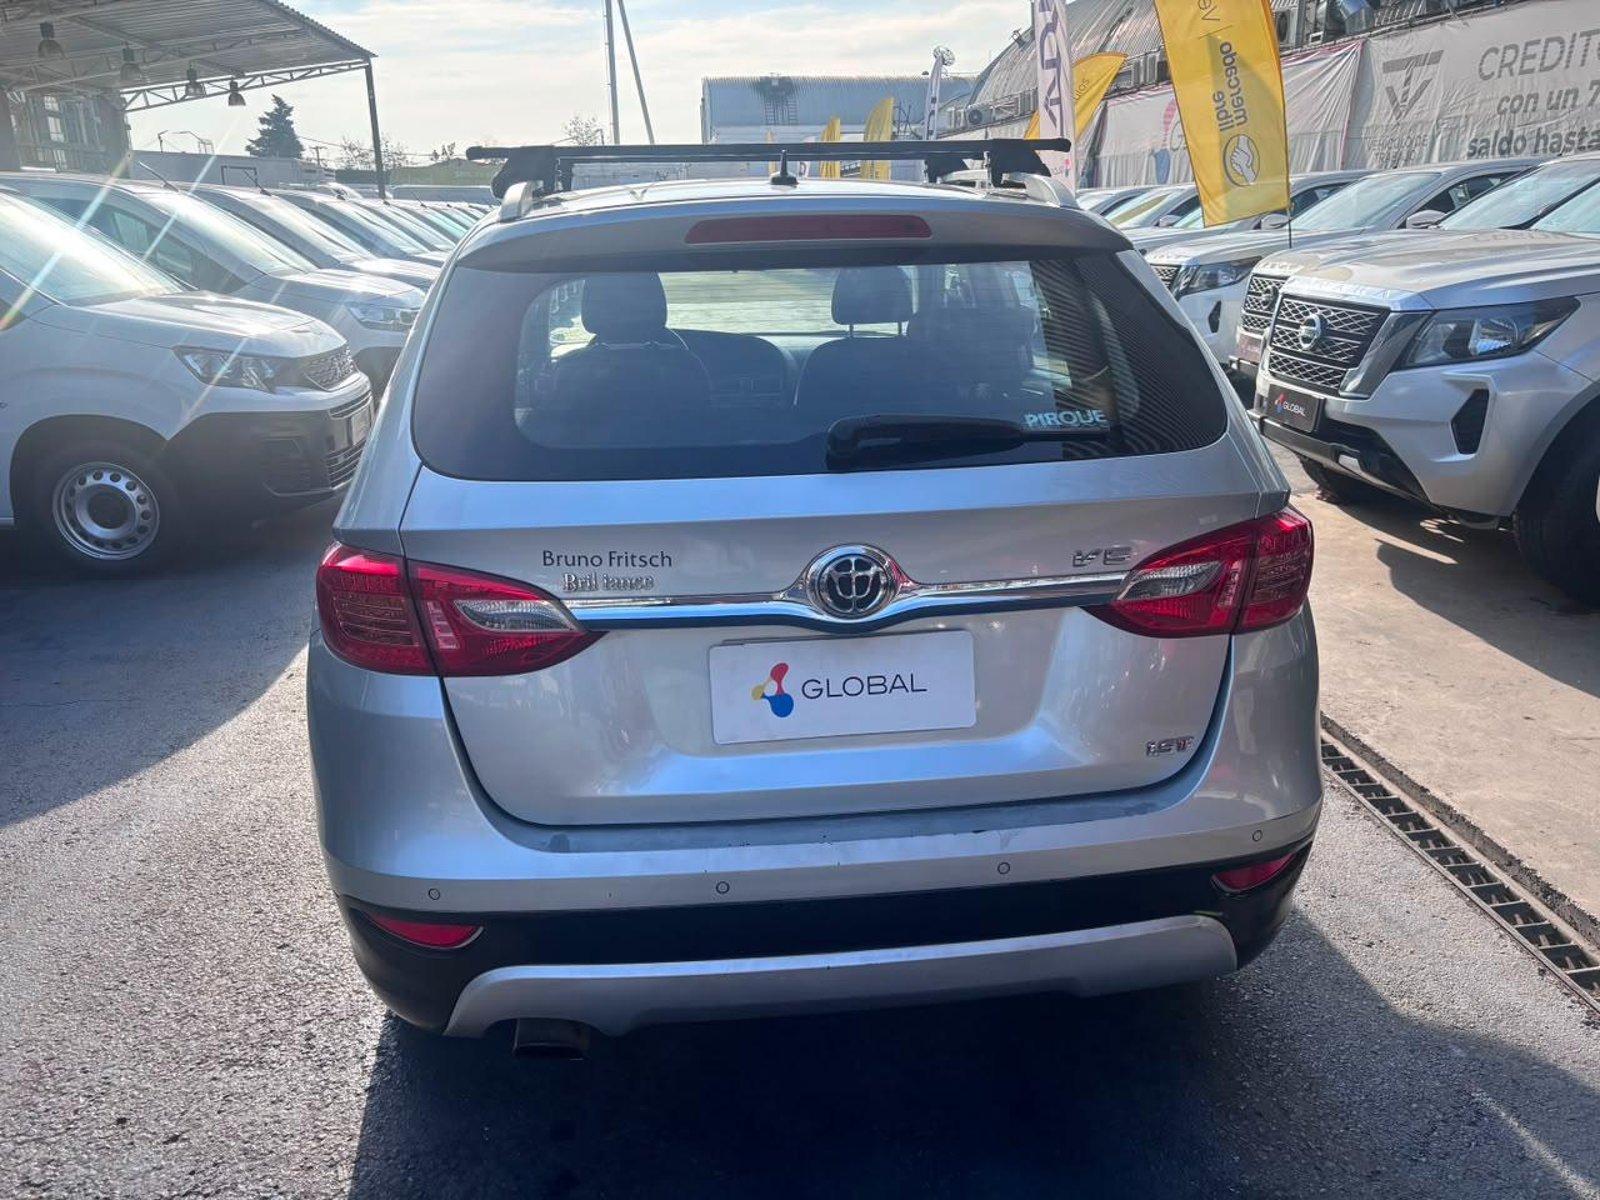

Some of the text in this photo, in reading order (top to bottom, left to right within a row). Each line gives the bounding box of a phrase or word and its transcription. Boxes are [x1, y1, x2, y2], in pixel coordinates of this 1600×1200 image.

[1479, 29, 1600, 80] CREDIT
[1497, 92, 1539, 115] con
[1546, 87, 1579, 111] un
[1467, 129, 1527, 158] saldo
[542, 550, 673, 568] Bruno Fritsch
[801, 672, 928, 699] GLOBAL
